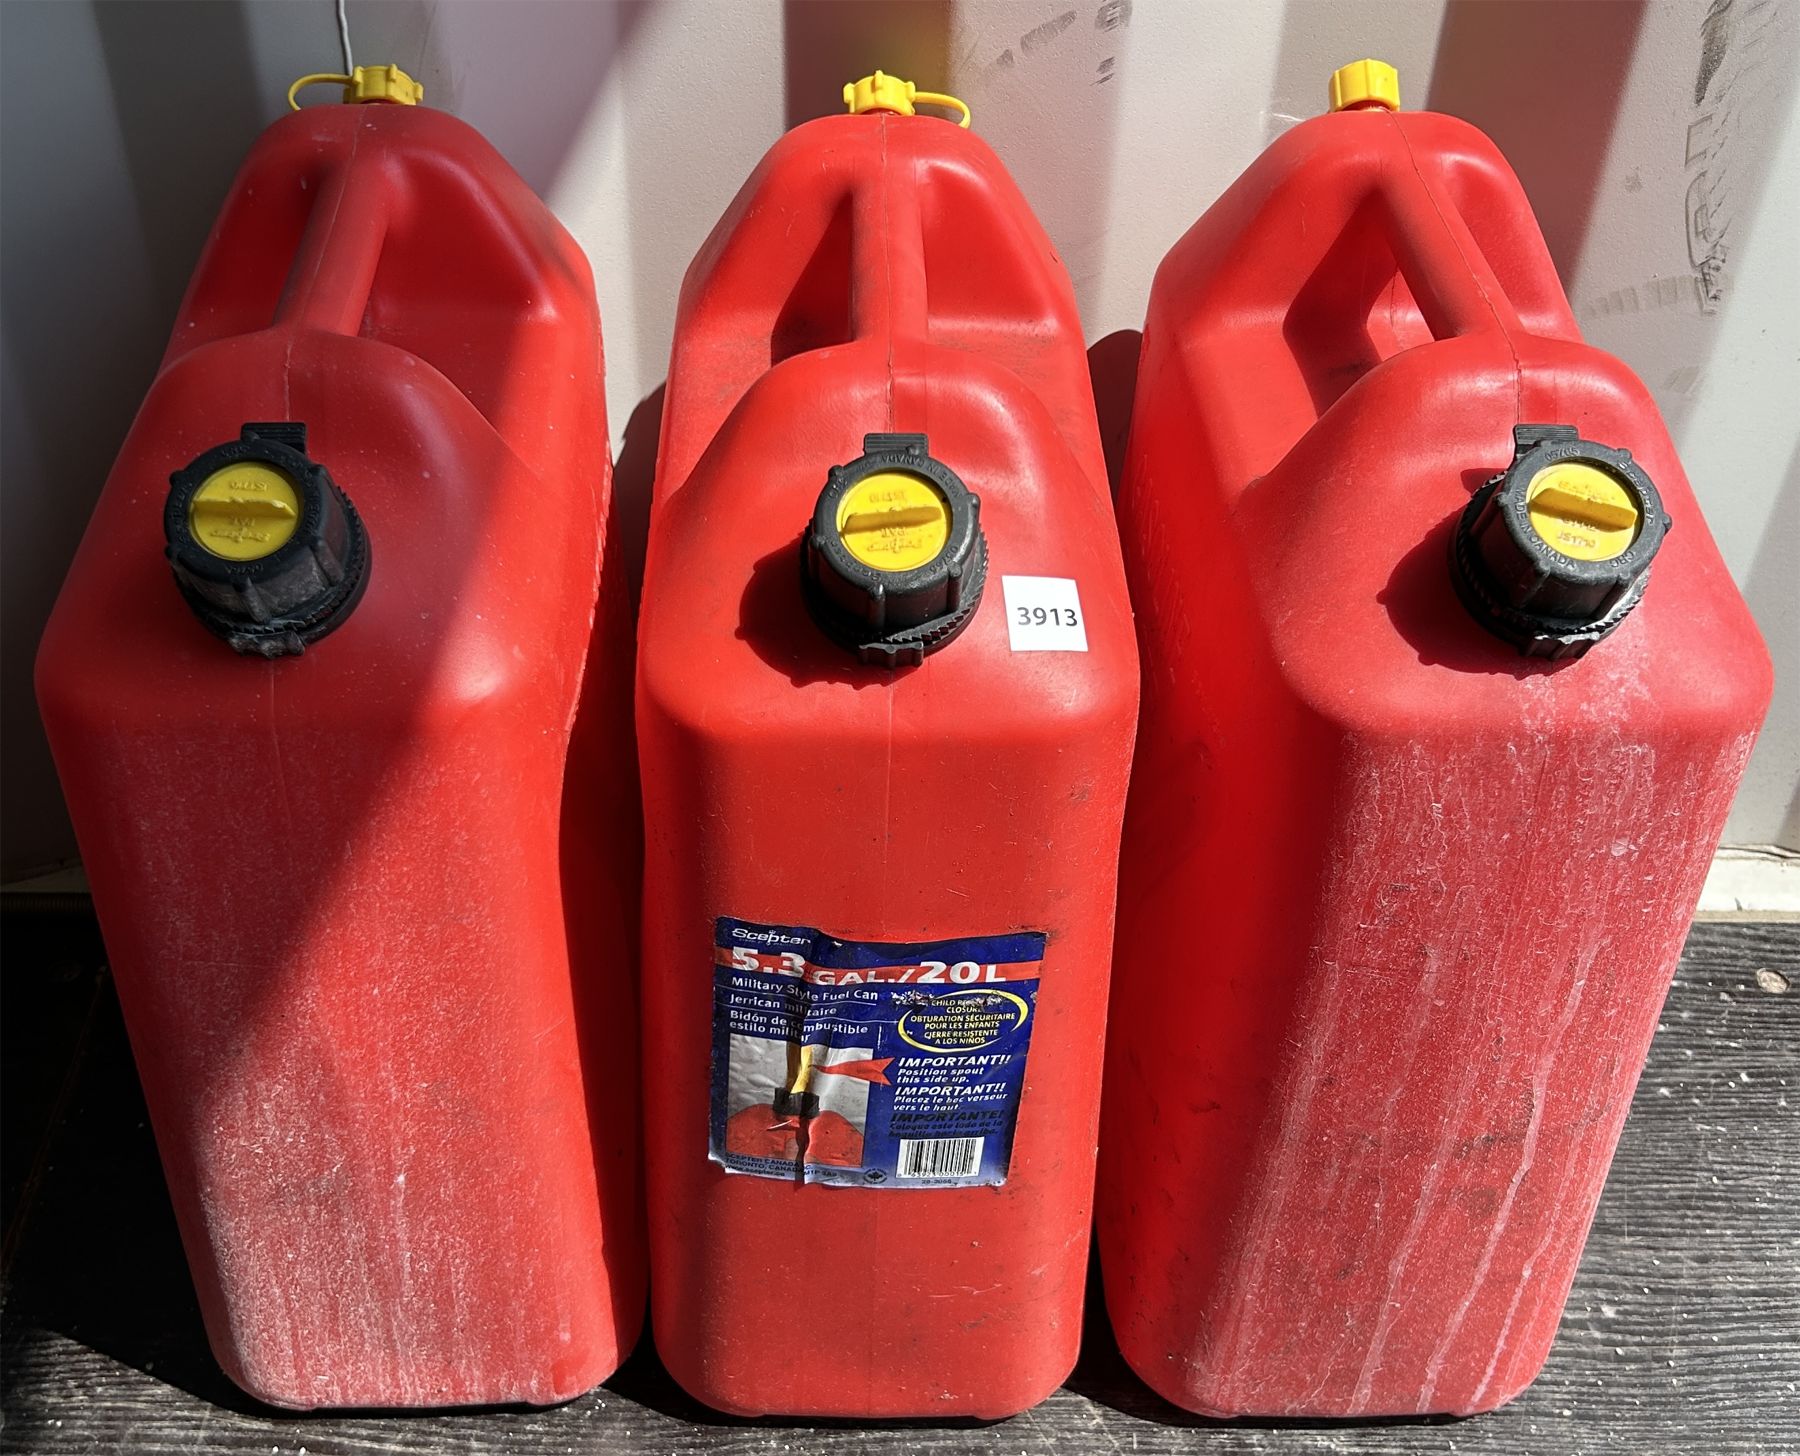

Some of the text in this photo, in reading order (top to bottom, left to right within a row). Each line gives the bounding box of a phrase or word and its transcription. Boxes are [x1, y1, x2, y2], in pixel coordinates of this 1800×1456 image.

[880, 454, 924, 467] CANADA
[928, 463, 940, 476] IN
[1514, 488, 1577, 570] MADE IN CANADA
[1609, 551, 1636, 568] CRC
[1017, 607, 1077, 627] 3913
[732, 928, 811, 946] Scepter
[732, 946, 805, 978] 5.3
[732, 977, 878, 1001] Military Style Fuel Can
[730, 994, 837, 1016] Jerrican militaire
[730, 1010, 868, 1034] Bidón de combustible
[911, 1012, 1016, 1023] OBTURATION SÉCURITAIRE
[729, 1021, 766, 1033] estilo
[924, 1022, 947, 1030] POUR
[964, 1020, 1000, 1029] ENFANTS
[953, 1029, 998, 1038] RESISTENTE
[959, 1036, 986, 1045] NIÑOS
[898, 1054, 1012, 1067] IMPORTANT!!
[898, 1067, 985, 1077] Position spout
[896, 1076, 920, 1084] this
[951, 1076, 970, 1085] up.
[895, 1082, 1007, 1096] IMPORTANT!!
[967, 1093, 1008, 1102] verseur
